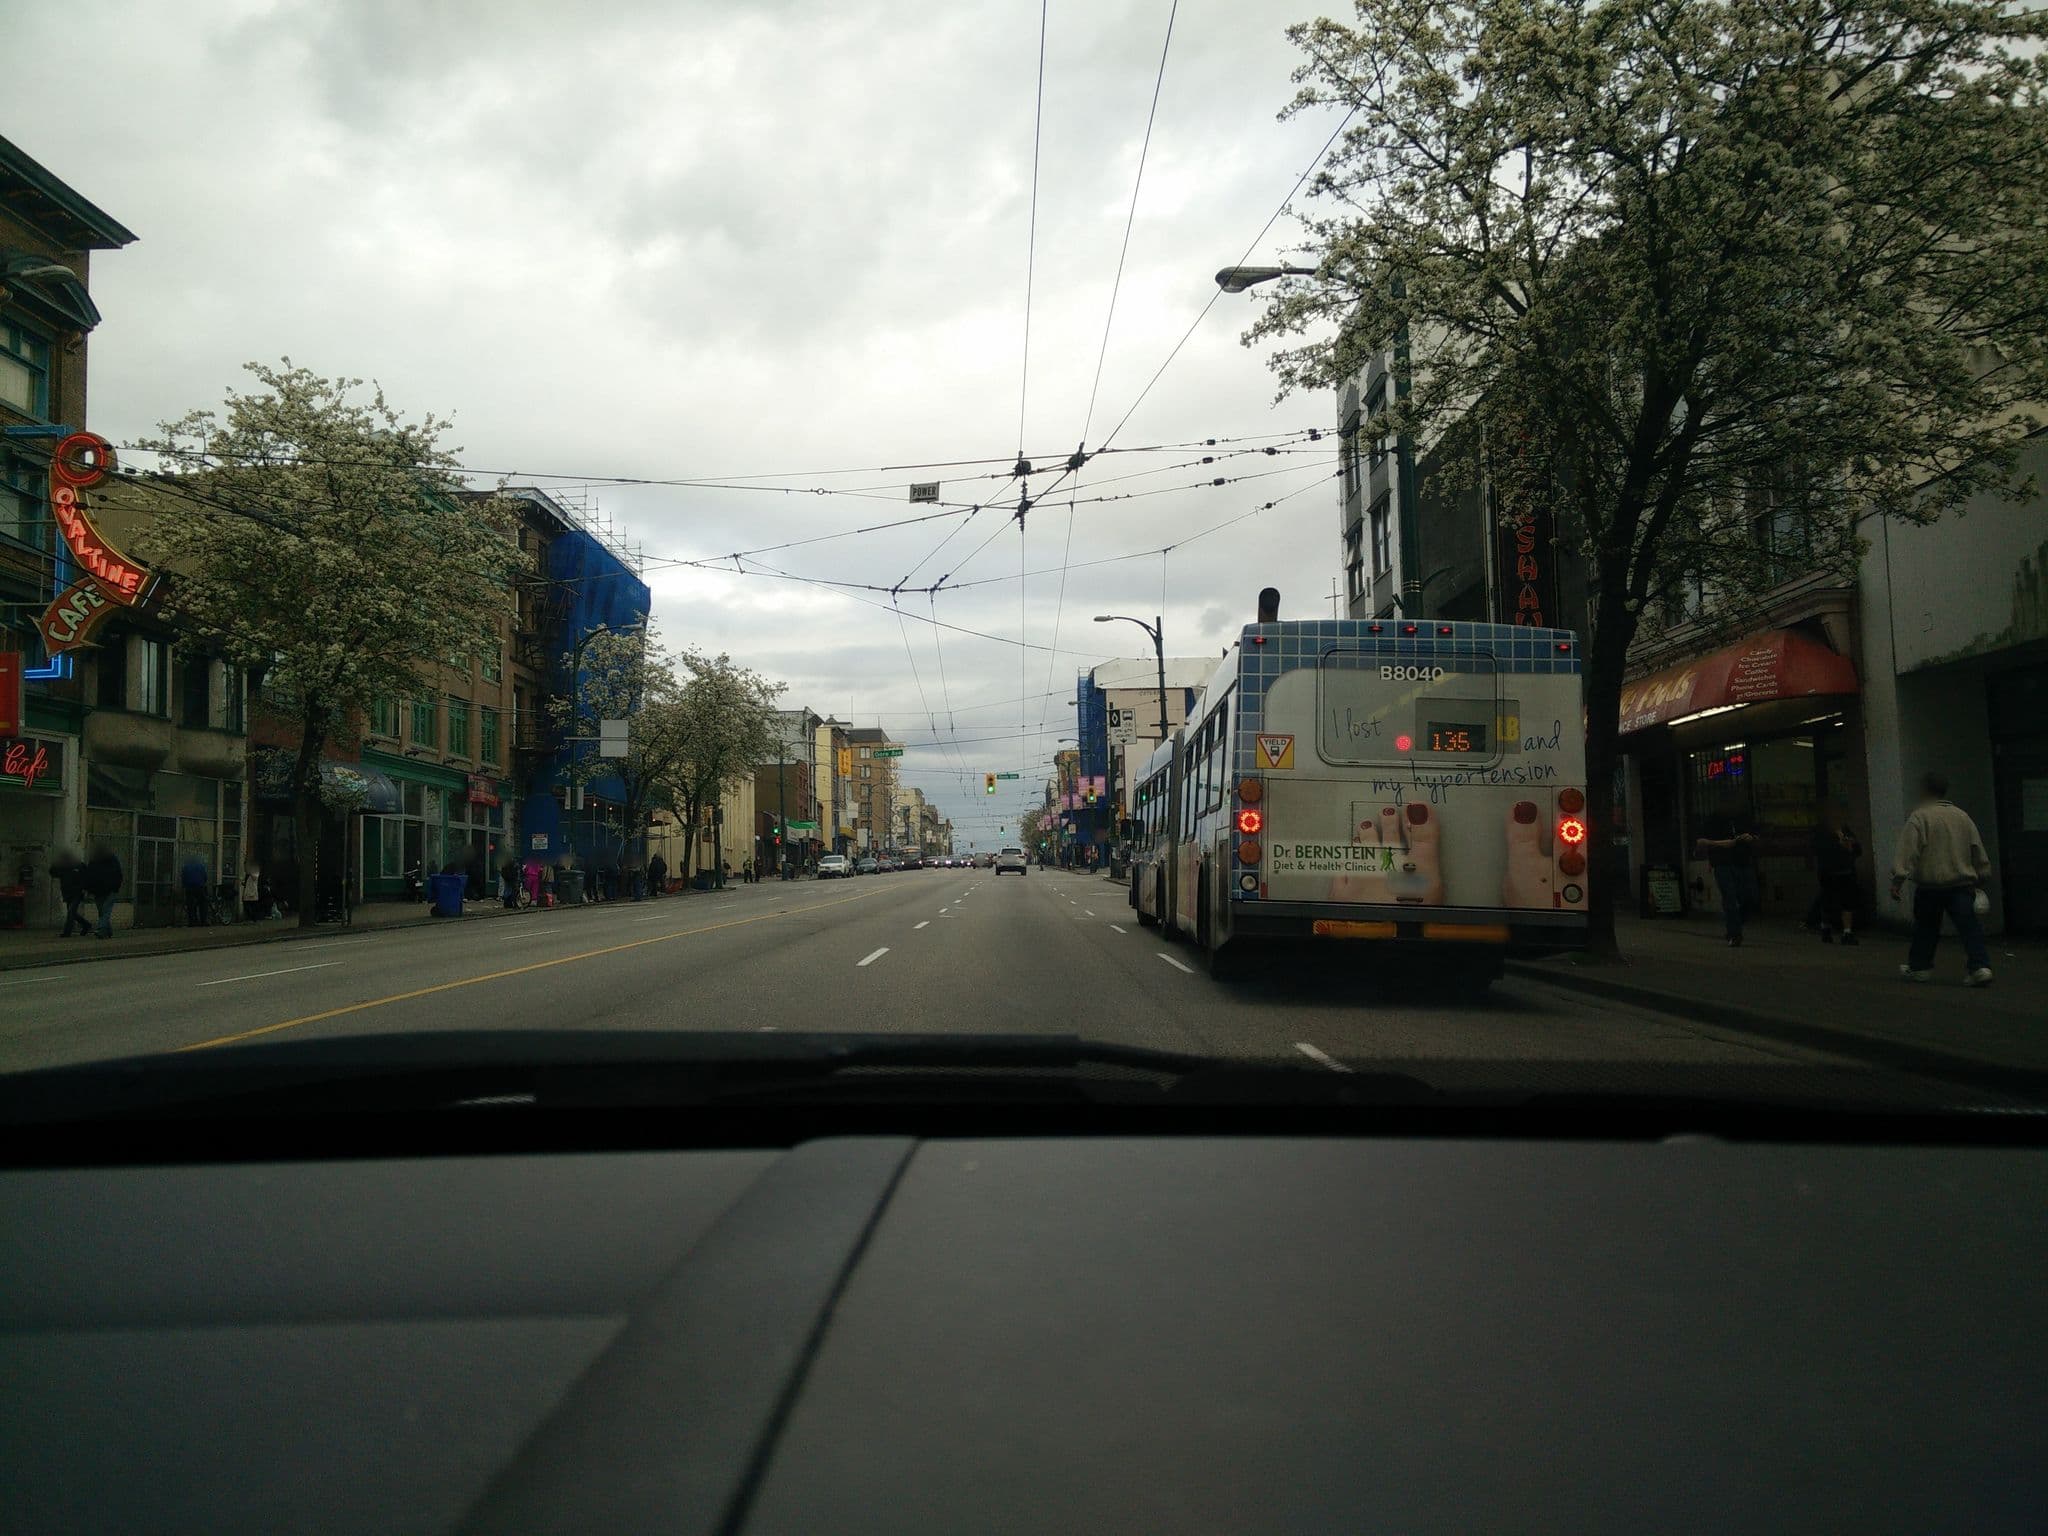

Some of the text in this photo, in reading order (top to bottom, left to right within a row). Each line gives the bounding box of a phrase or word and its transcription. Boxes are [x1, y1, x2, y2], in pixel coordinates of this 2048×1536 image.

[912, 486, 937, 497] POWER
[53, 487, 140, 594] OVALTINE
[48, 583, 106, 642] CAFE
[1380, 665, 1444, 681] B8040
[1346, 707, 1382, 743] lost
[1635, 711, 1657, 728] STORE
[1263, 738, 1287, 746] YIELD
[1432, 730, 1473, 752] 135
[1524, 719, 1561, 752] and
[1371, 758, 1557, 807] my hypertension
[1273, 844, 1376, 860] Dr. BERNSTEIN
[1273, 860, 1376, 872] Diet & Health Clinics
